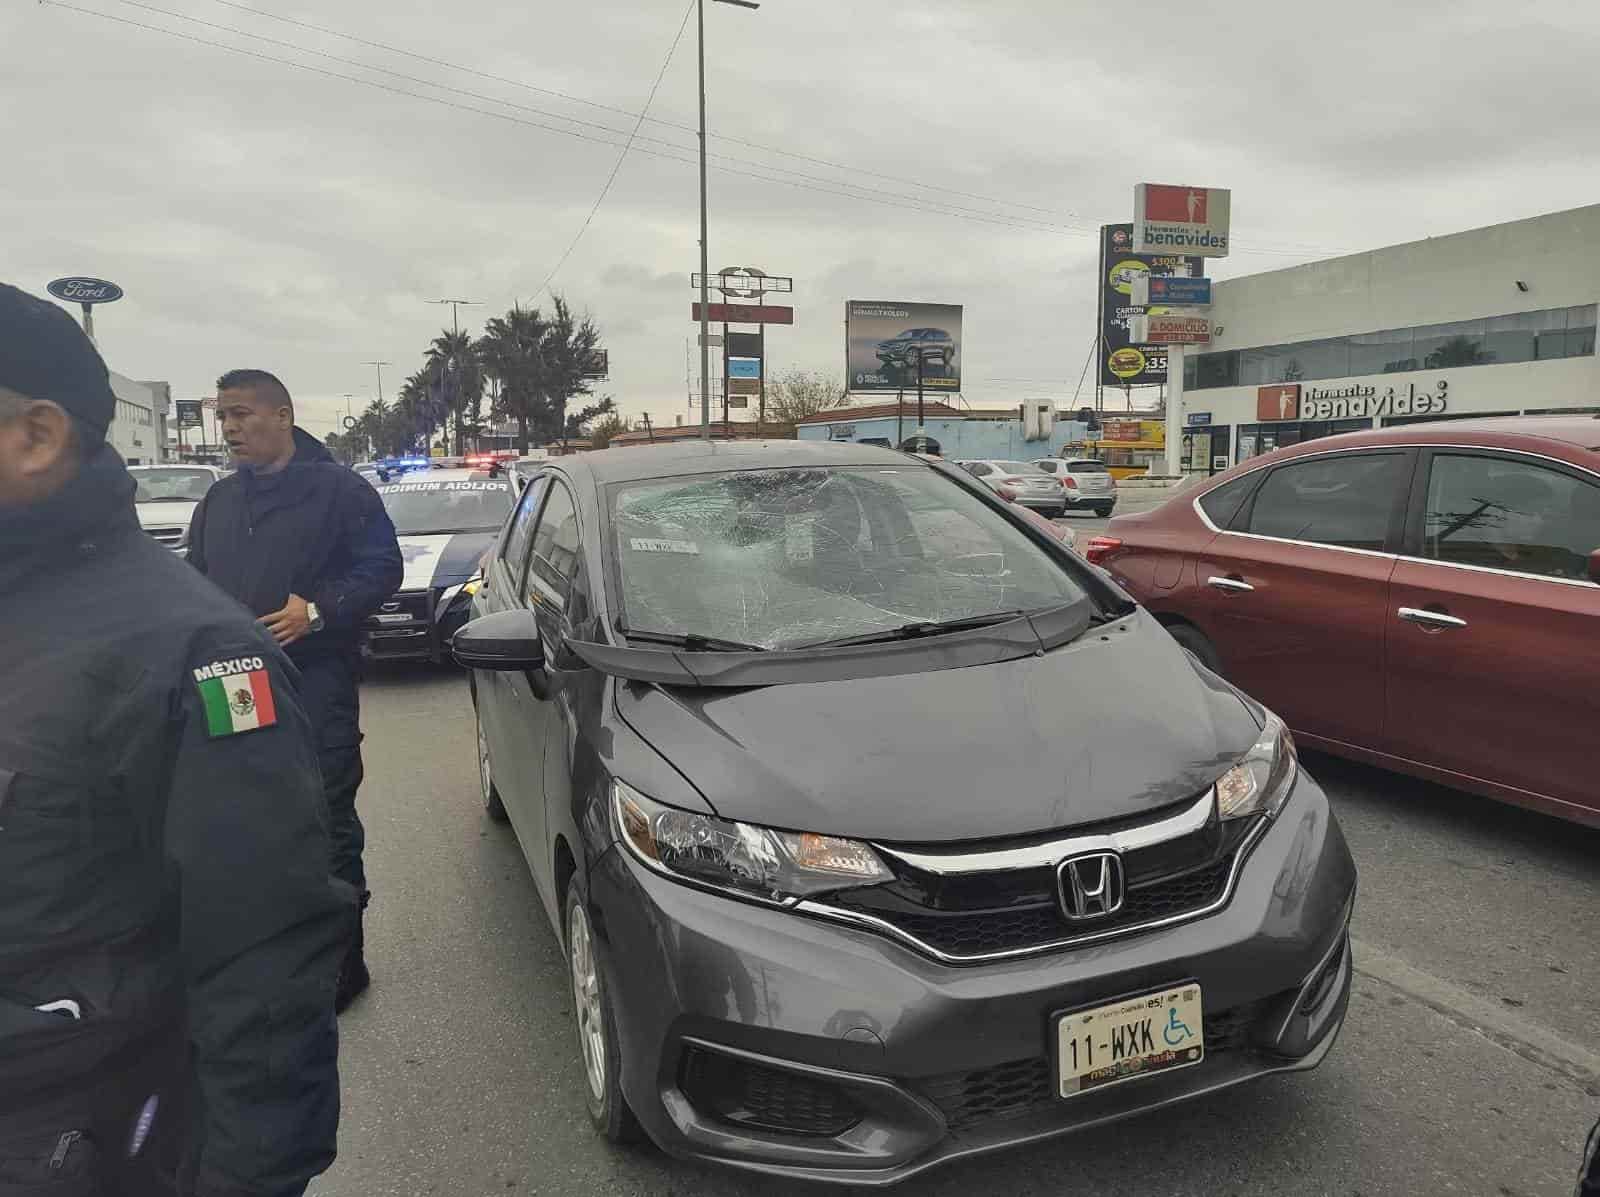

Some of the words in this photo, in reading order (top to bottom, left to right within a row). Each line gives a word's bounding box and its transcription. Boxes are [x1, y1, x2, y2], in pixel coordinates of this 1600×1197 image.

[1144, 229, 1226, 248] benavides
[64, 280, 106, 298] Ford
[1303, 384, 1447, 420] benavides
[1312, 384, 1375, 399] farmacias
[193, 657, 263, 681] MÉXICO
[1070, 1018, 1155, 1071] 11-WXK
